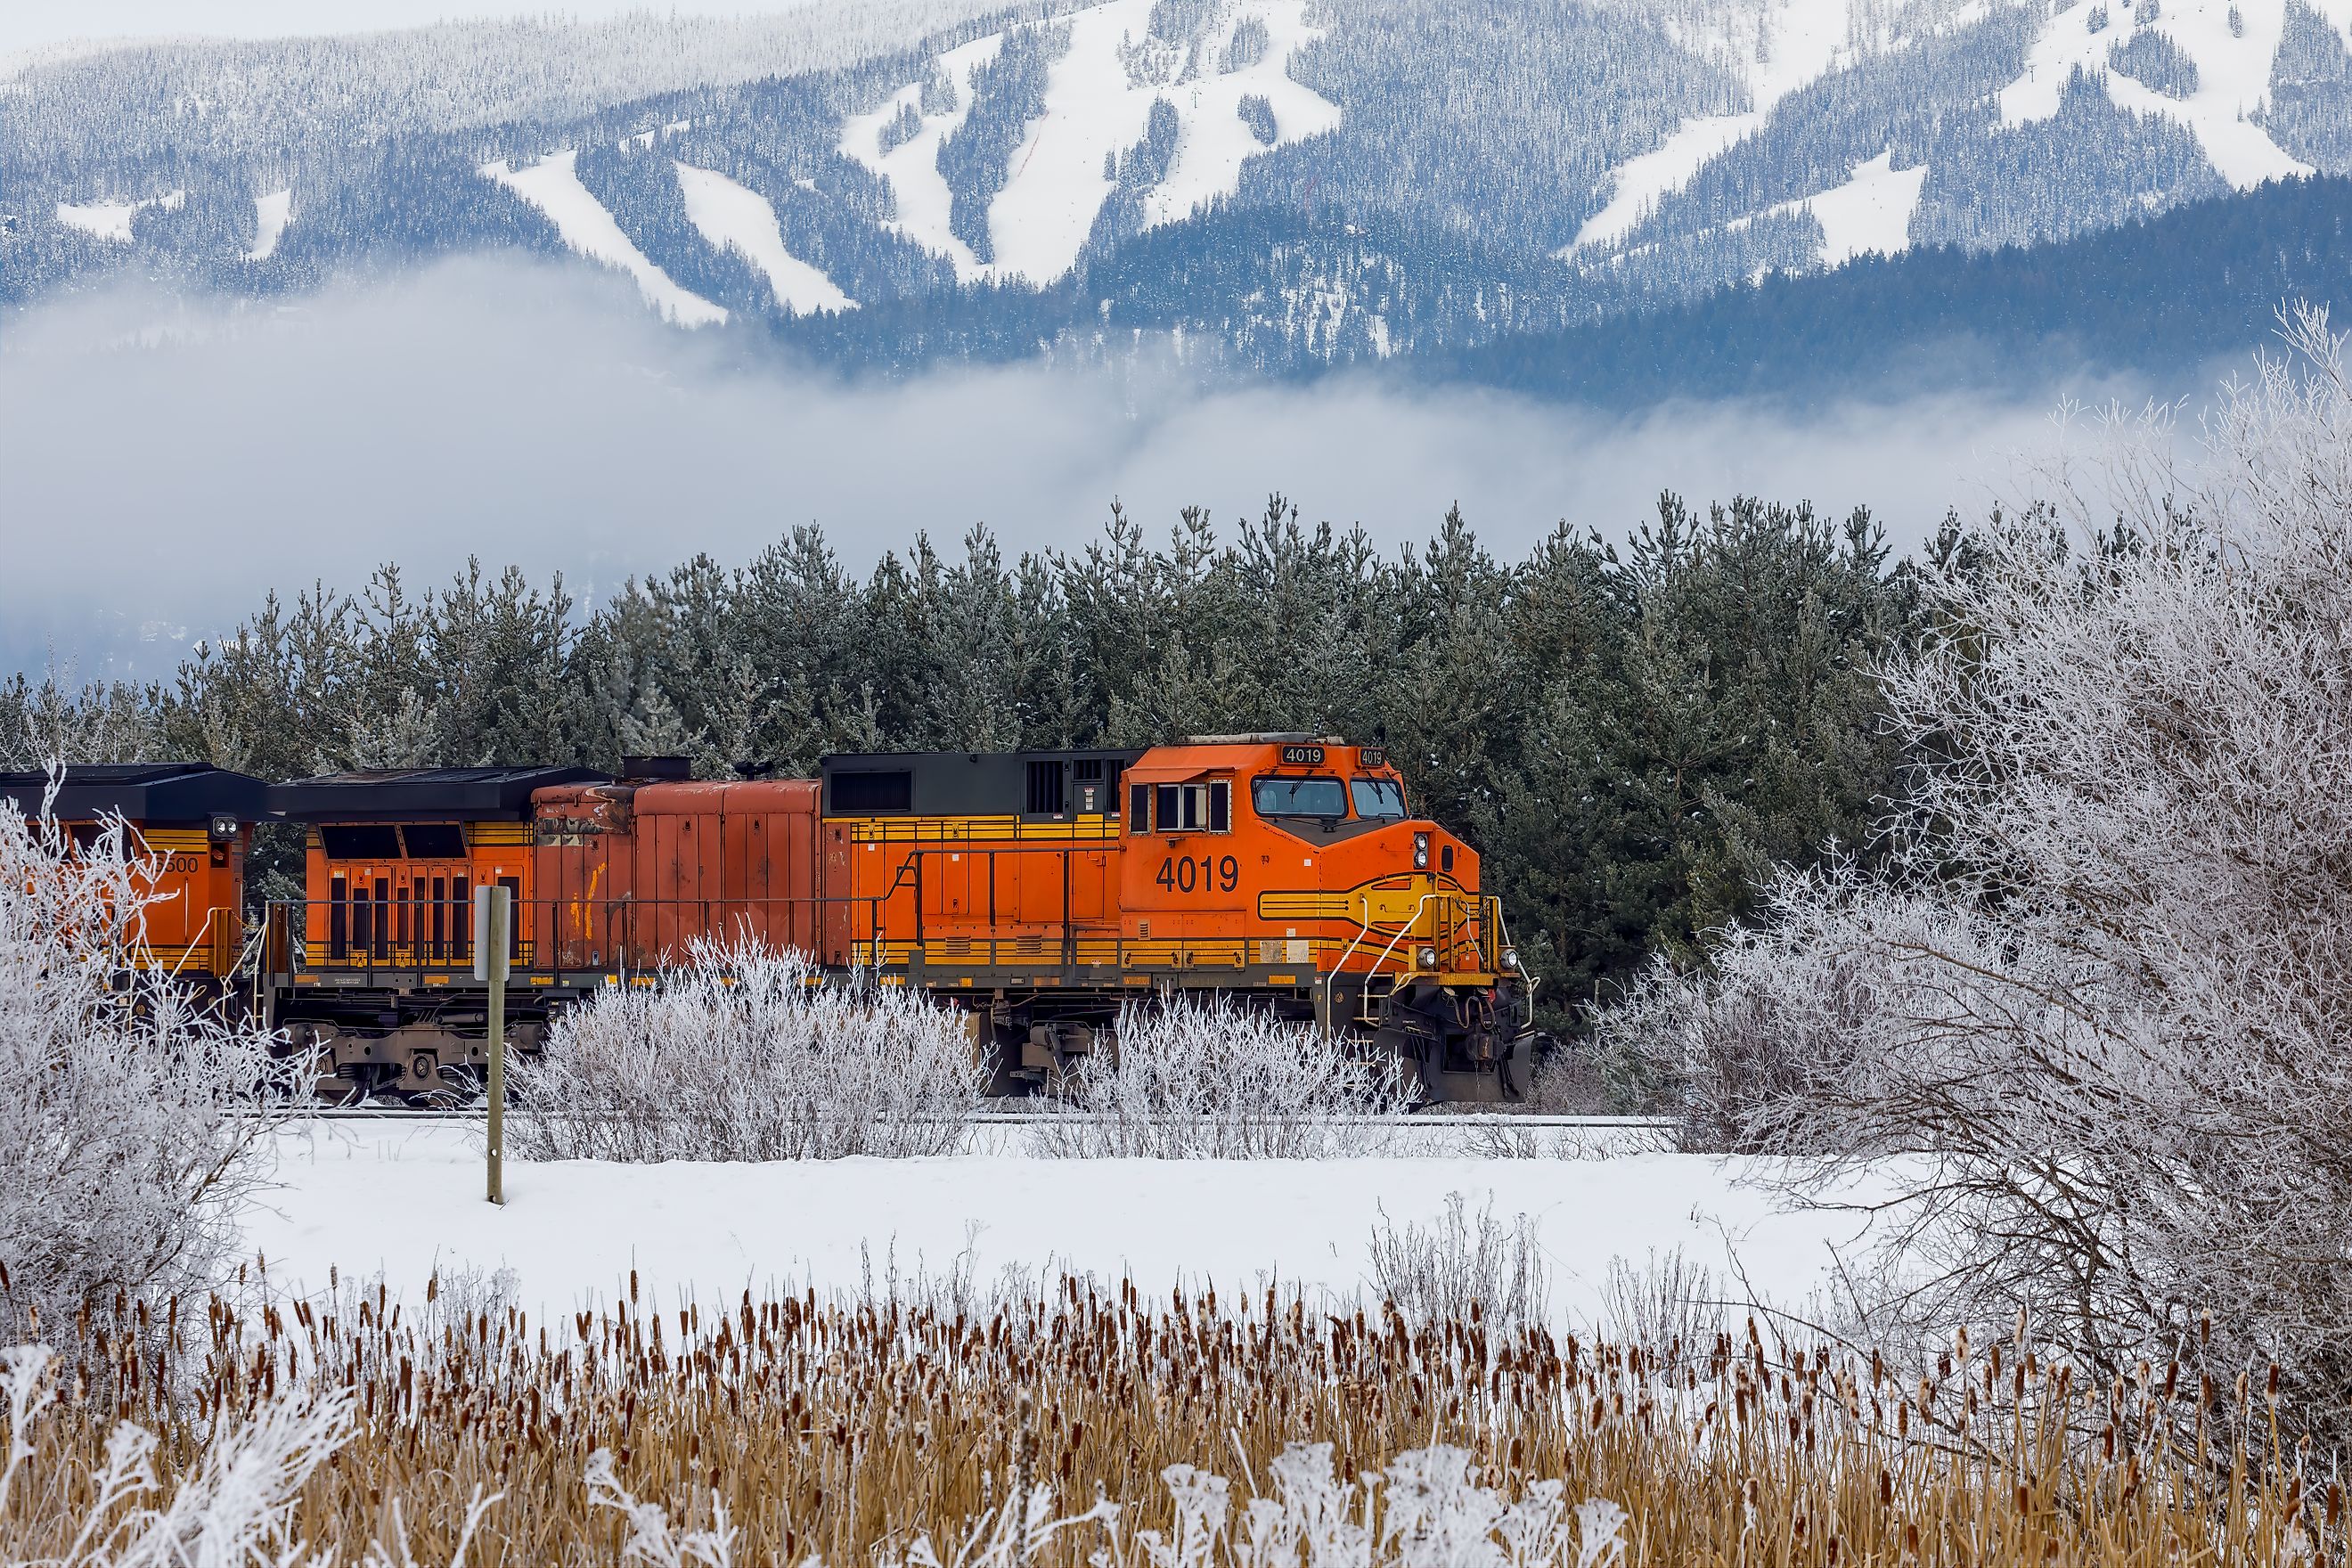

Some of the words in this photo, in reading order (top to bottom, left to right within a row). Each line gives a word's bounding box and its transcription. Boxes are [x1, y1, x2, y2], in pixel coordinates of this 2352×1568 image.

[1286, 747, 1321, 763] 4019
[1362, 749, 1382, 764] 4019
[1156, 854, 1239, 893] 4019
